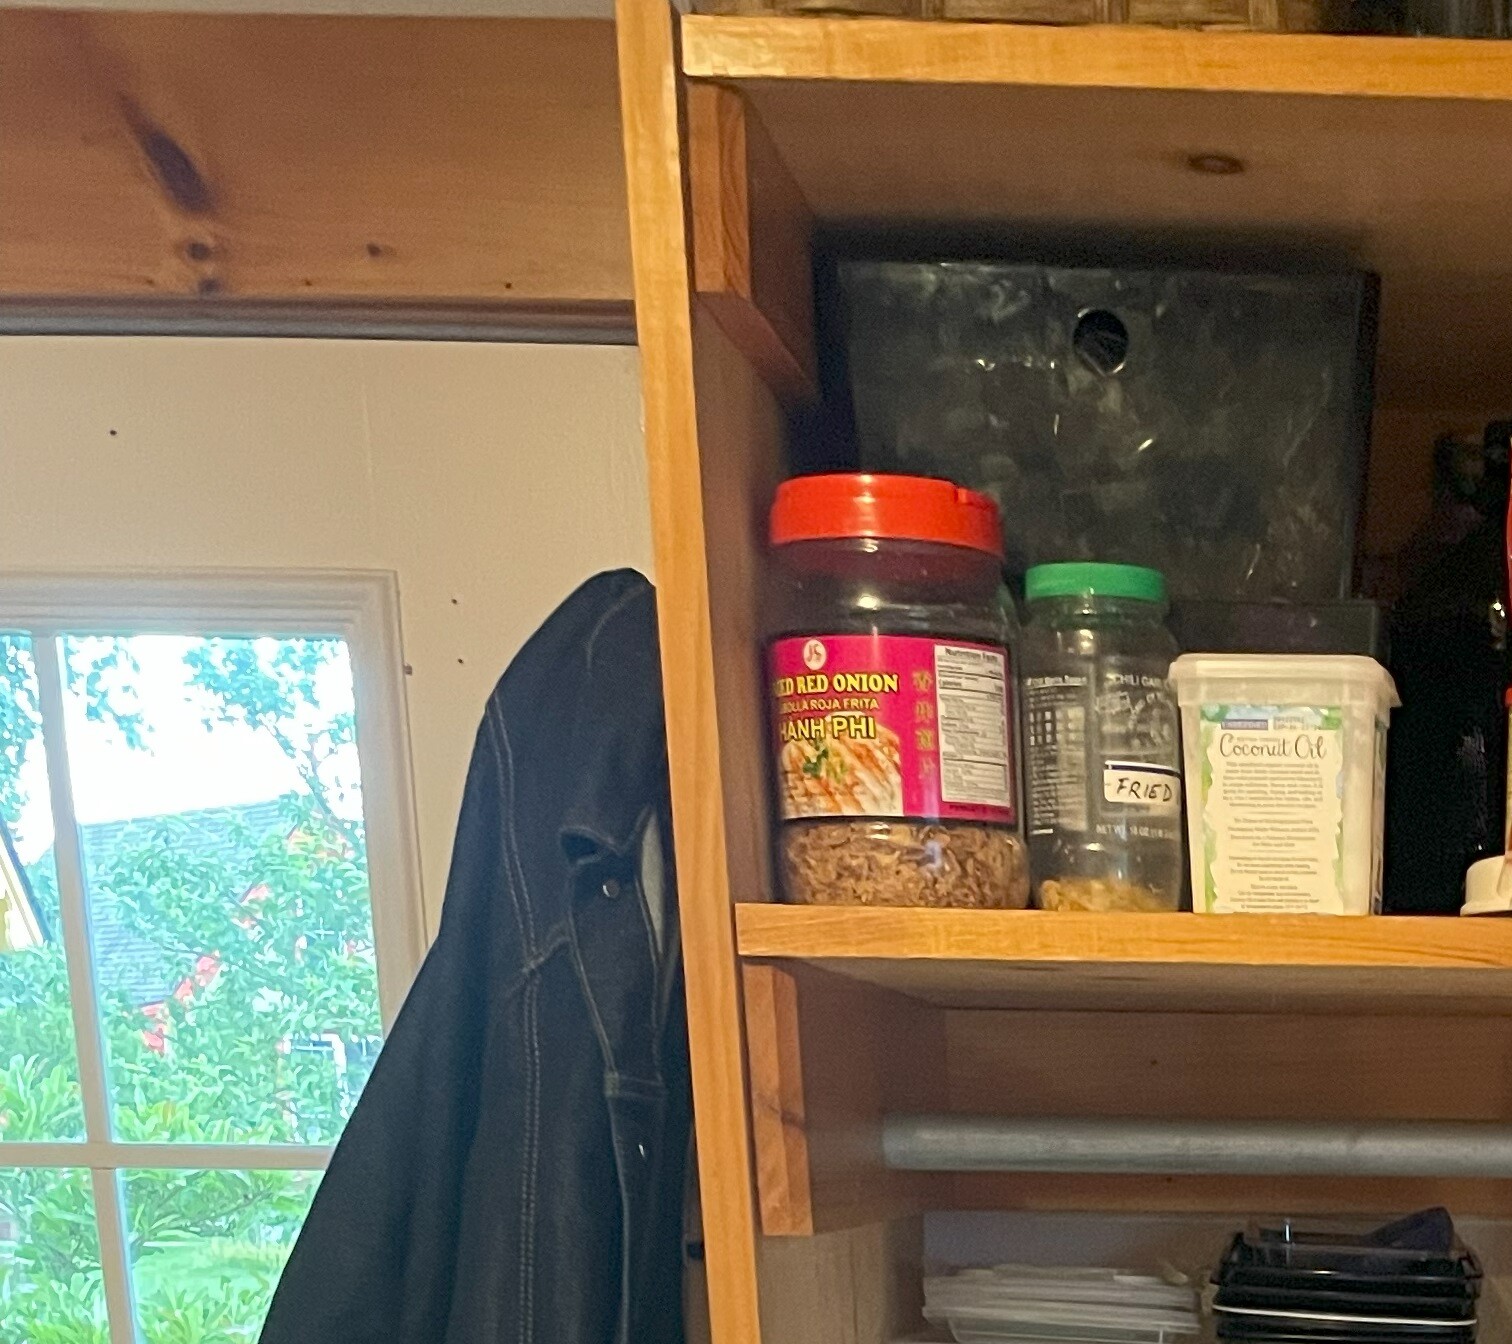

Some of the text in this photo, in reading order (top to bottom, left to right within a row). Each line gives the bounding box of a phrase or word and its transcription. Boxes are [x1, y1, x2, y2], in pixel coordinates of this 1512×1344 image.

[796, 674, 828, 694] RED
[832, 673, 899, 693] ONION
[810, 697, 841, 711] ROJA
[843, 697, 879, 710] FRITA
[831, 716, 877, 740] PHI
[1219, 732, 1328, 760] Coconut Oil
[1116, 777, 1173, 803] FRIED
